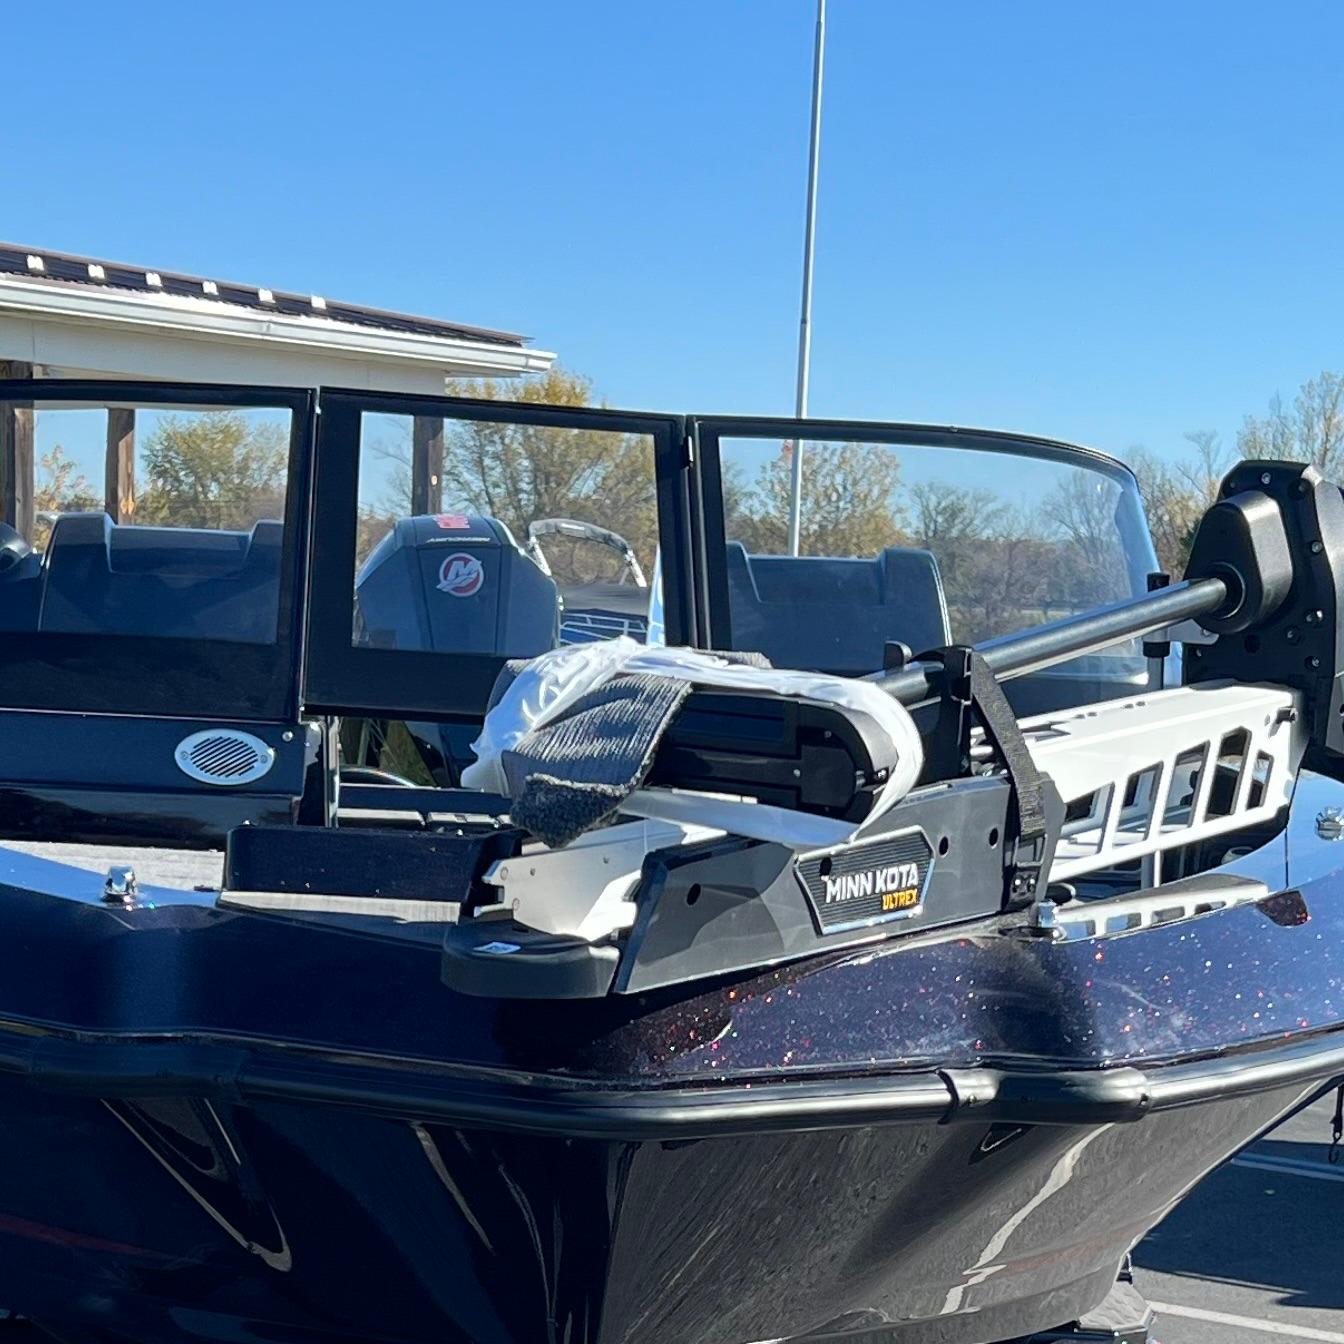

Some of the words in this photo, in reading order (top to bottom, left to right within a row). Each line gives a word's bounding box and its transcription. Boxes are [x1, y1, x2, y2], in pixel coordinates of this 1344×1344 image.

[826, 872, 873, 904] MINN
[875, 862, 920, 894] KOTA
[882, 888, 918, 911] ULTREX
